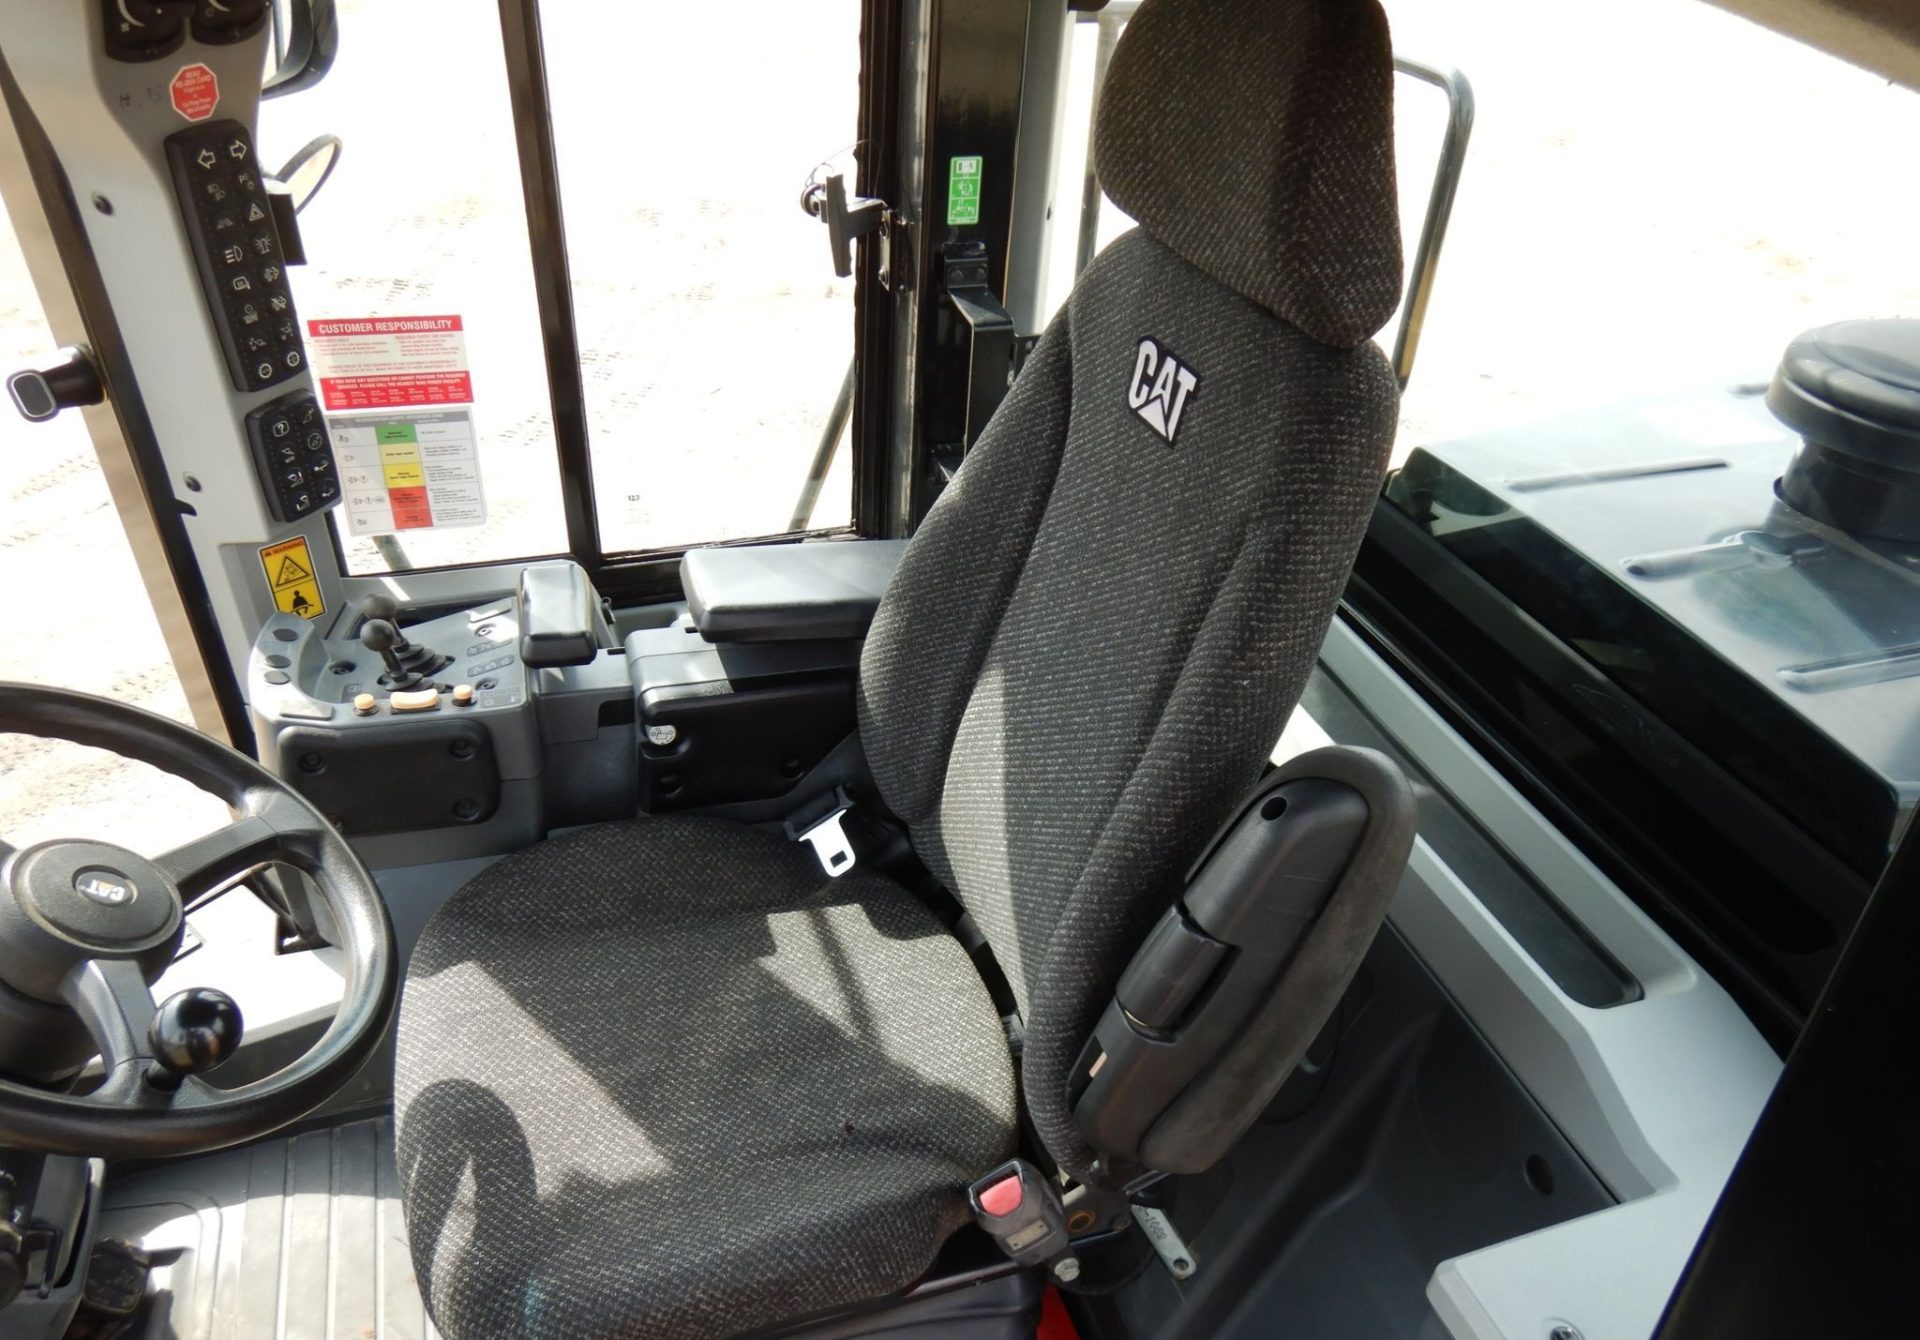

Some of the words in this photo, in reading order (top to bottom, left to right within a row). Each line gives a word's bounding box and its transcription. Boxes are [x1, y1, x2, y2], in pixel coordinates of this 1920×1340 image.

[319, 322, 373, 334] CUSTOMER
[375, 319, 452, 332] RESPONSIBILITY
[1128, 340, 1197, 442] CAT
[86, 879, 125, 901] CAT
